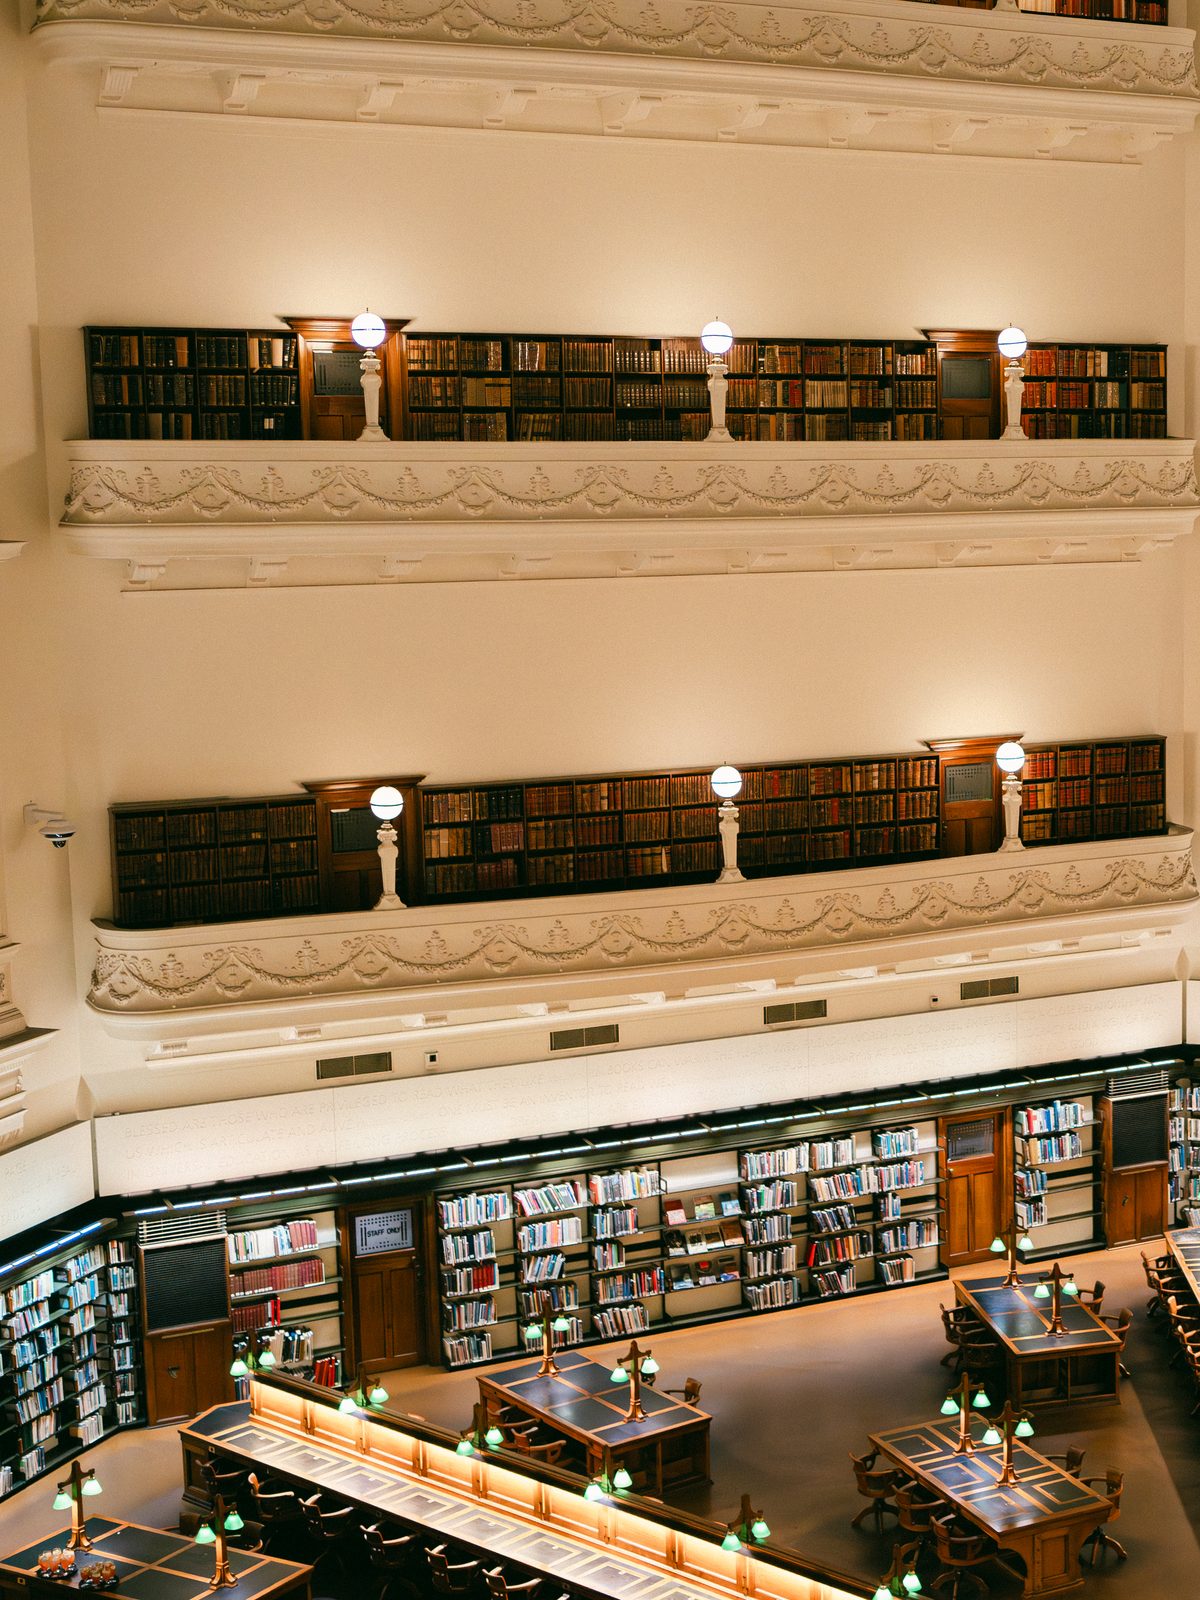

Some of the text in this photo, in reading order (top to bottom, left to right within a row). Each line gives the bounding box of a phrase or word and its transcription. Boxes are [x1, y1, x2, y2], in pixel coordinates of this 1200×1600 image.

[125, 1122, 178, 1138] BLESSED
[182, 1117, 207, 1131] ARE
[291, 1104, 315, 1117] ARE
[367, 1226, 401, 1238] STAFF ONLY
